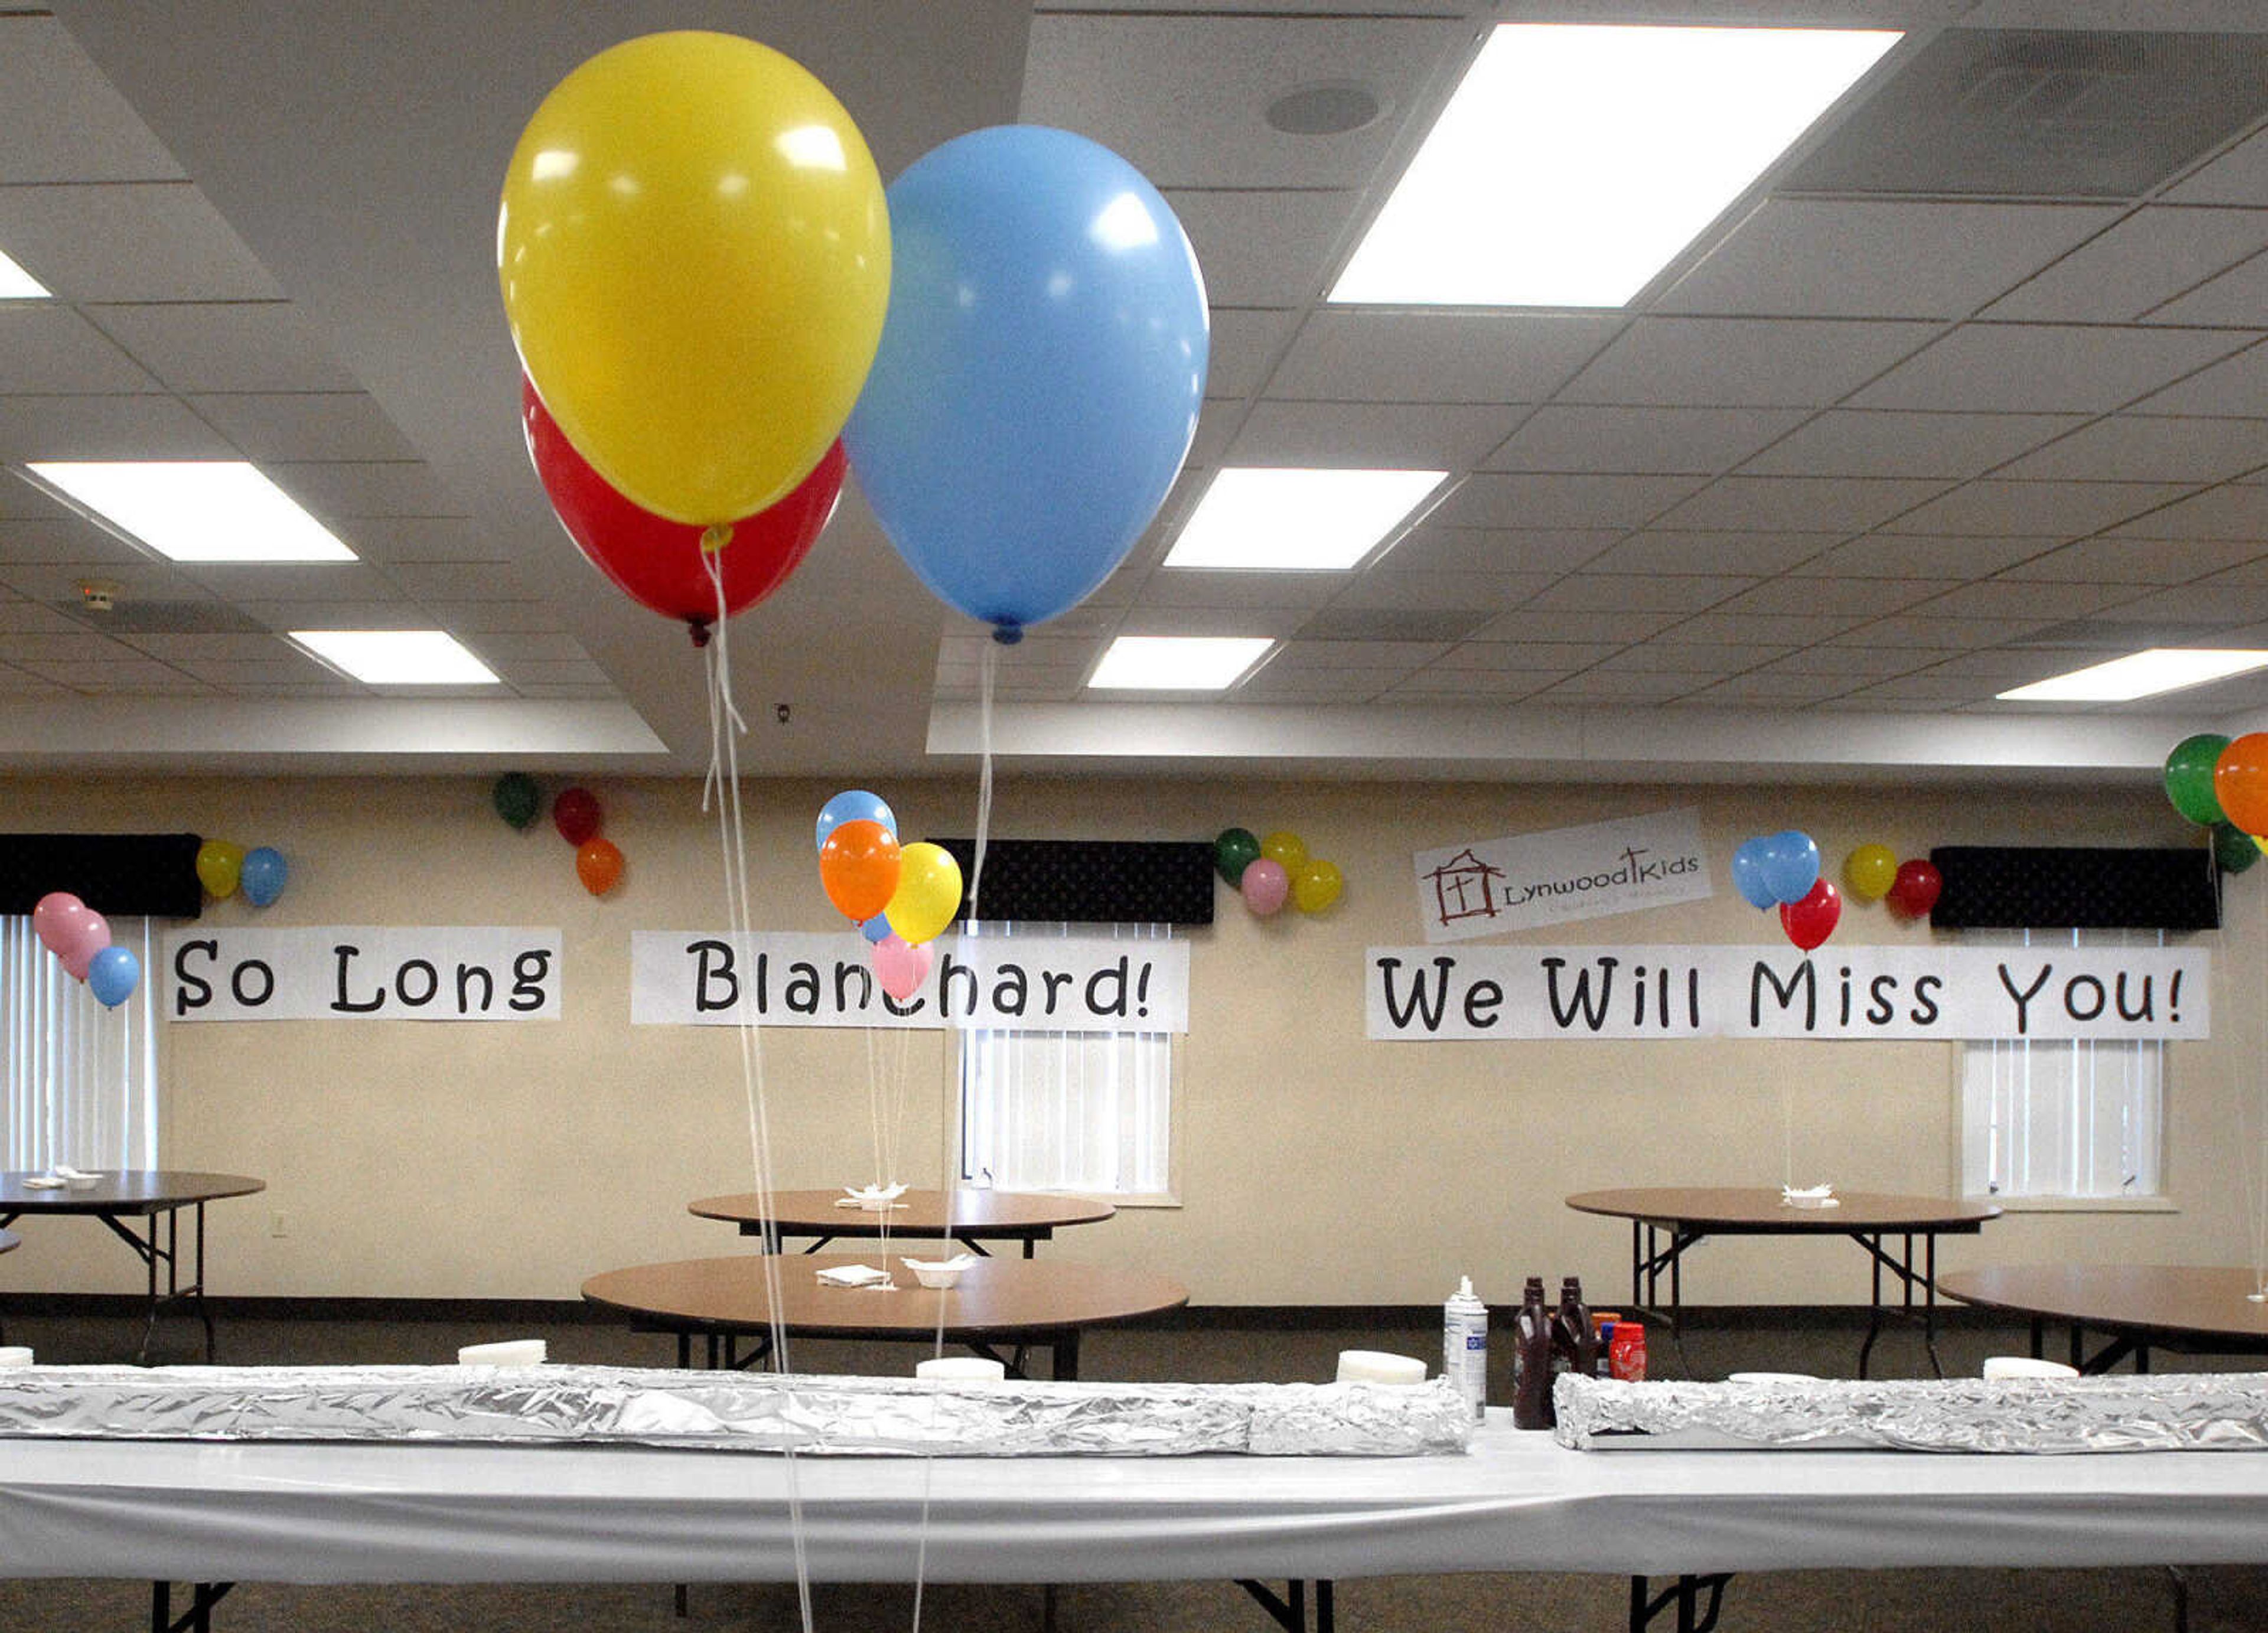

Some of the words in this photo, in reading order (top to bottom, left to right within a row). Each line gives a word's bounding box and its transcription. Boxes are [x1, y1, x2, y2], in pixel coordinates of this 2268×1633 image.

[1504, 866, 1628, 906] Lynwood
[1639, 856, 1700, 884] Kids
[174, 938, 275, 1017] So
[330, 944, 553, 1014] Long
[1376, 956, 1504, 1032] We
[1540, 956, 1699, 1032] Will
[1750, 959, 1943, 1032] Miss
[1997, 963, 2183, 1035] You!
